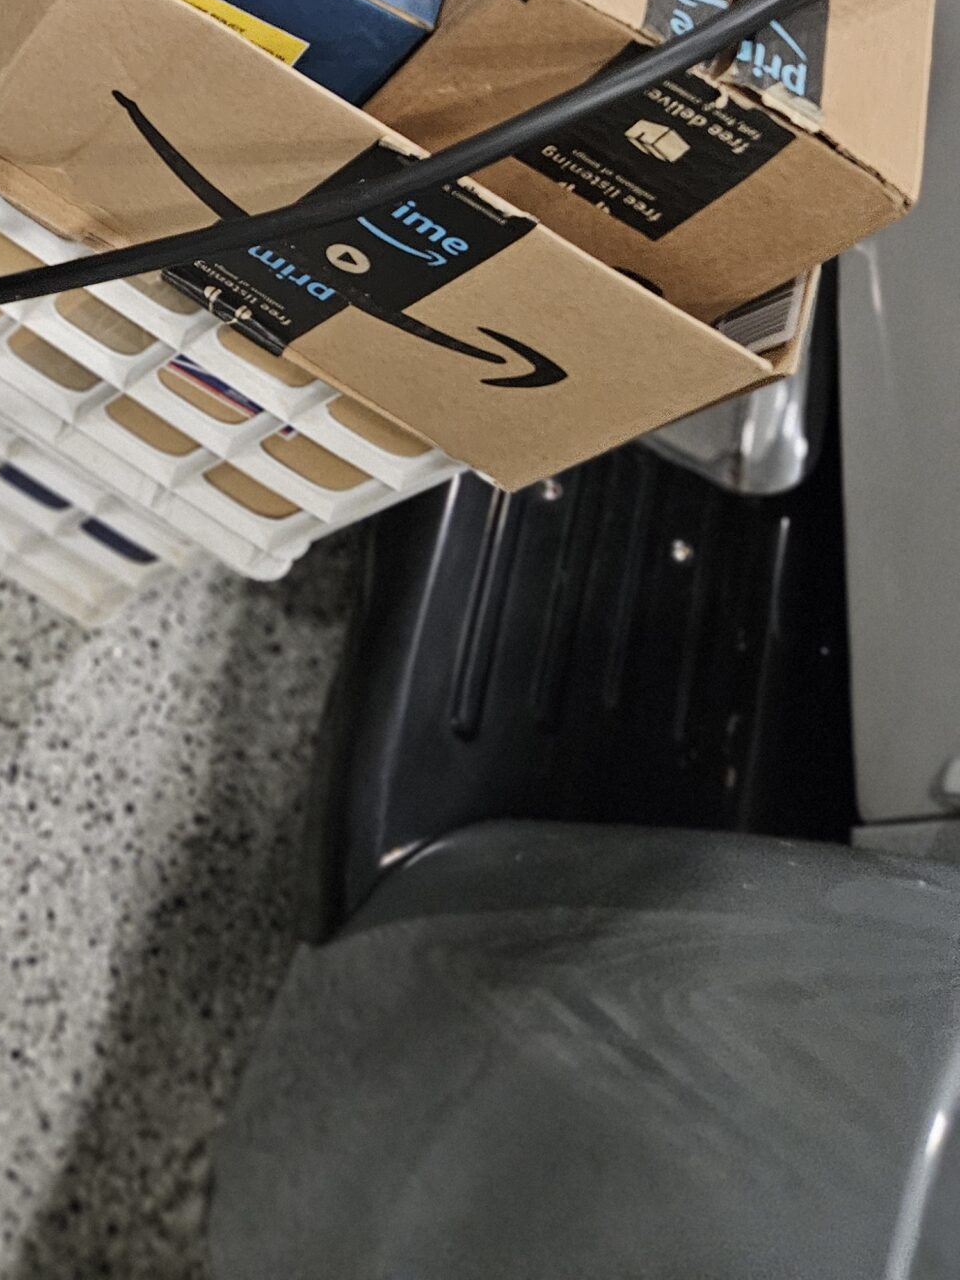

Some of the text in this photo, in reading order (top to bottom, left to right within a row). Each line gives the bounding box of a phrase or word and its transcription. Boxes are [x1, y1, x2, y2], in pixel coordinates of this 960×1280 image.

[667, 7, 805, 96] prie
[646, 86, 708, 127] delive
[707, 122, 749, 154] free
[540, 144, 661, 221] free listening
[390, 199, 470, 257] ime
[247, 244, 335, 301] prim
[259, 303, 292, 325] free
